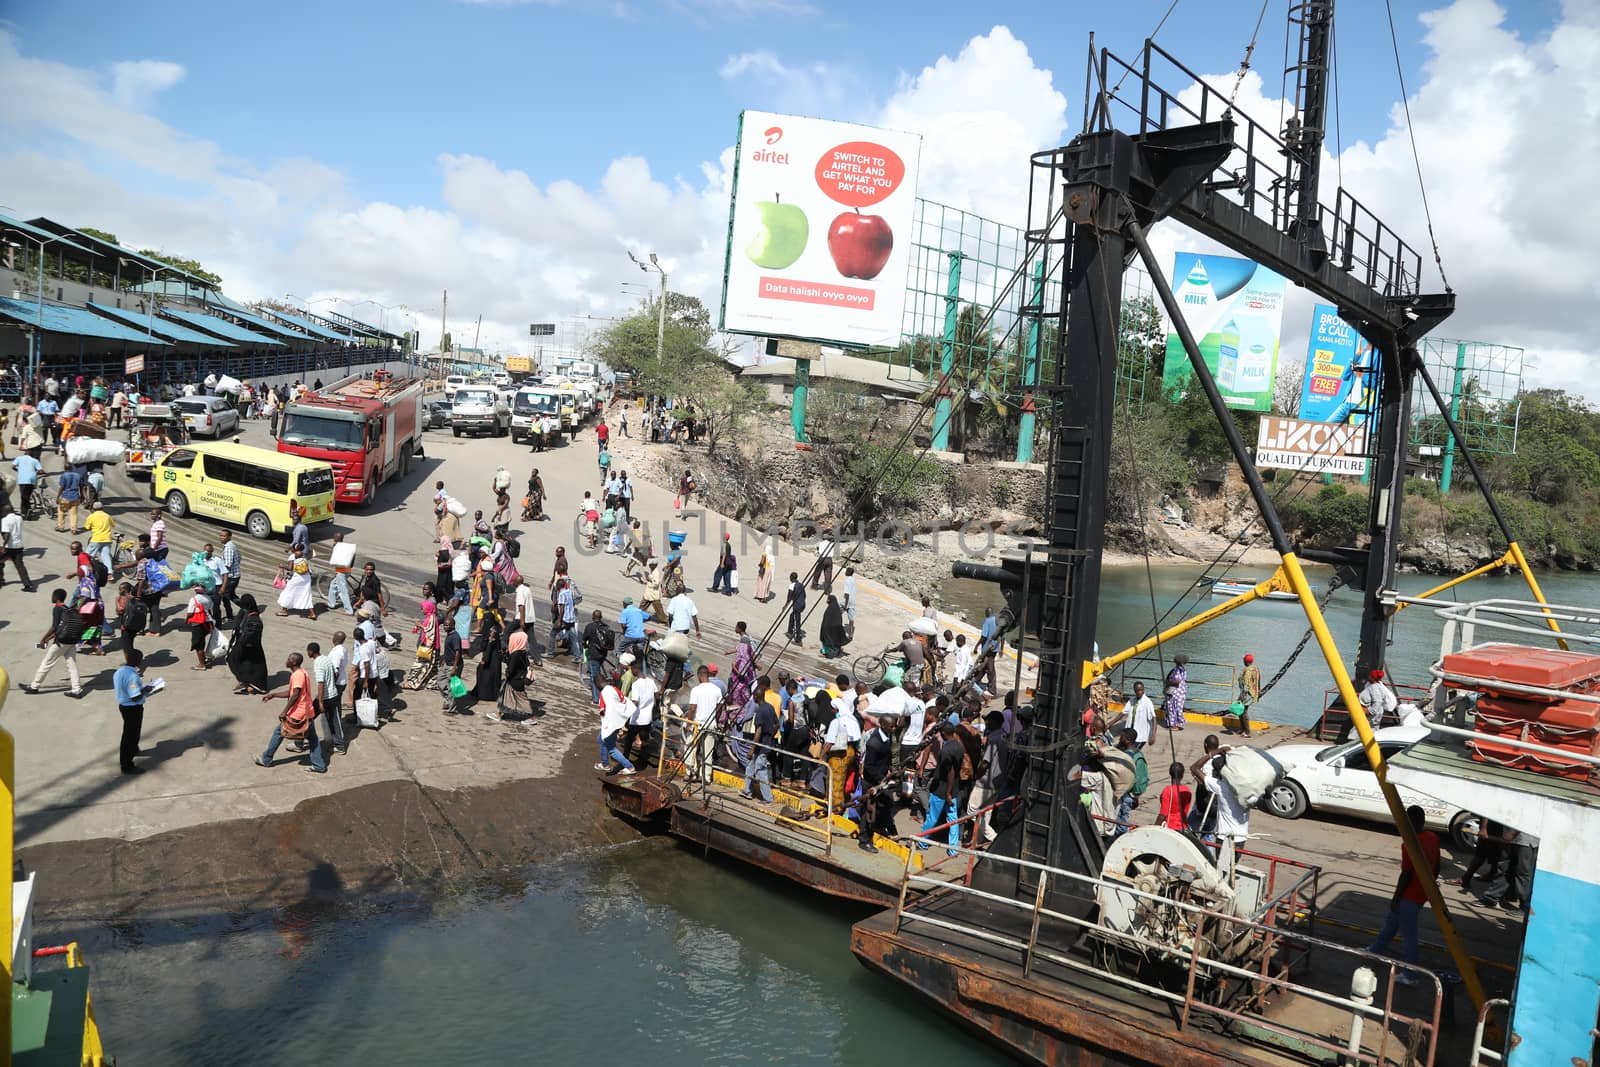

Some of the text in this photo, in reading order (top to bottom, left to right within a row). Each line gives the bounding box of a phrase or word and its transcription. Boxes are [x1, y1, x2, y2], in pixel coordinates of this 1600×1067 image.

[753, 149, 789, 165] airtel
[833, 151, 885, 167] SWITCH TO
[831, 162, 885, 177] AIRTEL AND
[823, 170, 892, 188] GET WHAT YOU
[838, 182, 875, 195] PAY FOR
[765, 283, 869, 304] Data halishi ovyo ovyo
[1185, 294, 1208, 305] MILK
[1318, 323, 1350, 338] & CALL
[1242, 367, 1265, 377] MILK
[1314, 378, 1337, 389] FREE
[1258, 452, 1365, 471] QUALITY FURNITURE
[206, 490, 234, 502] GREENWOOD
[219, 501, 240, 511] ACADEMY
